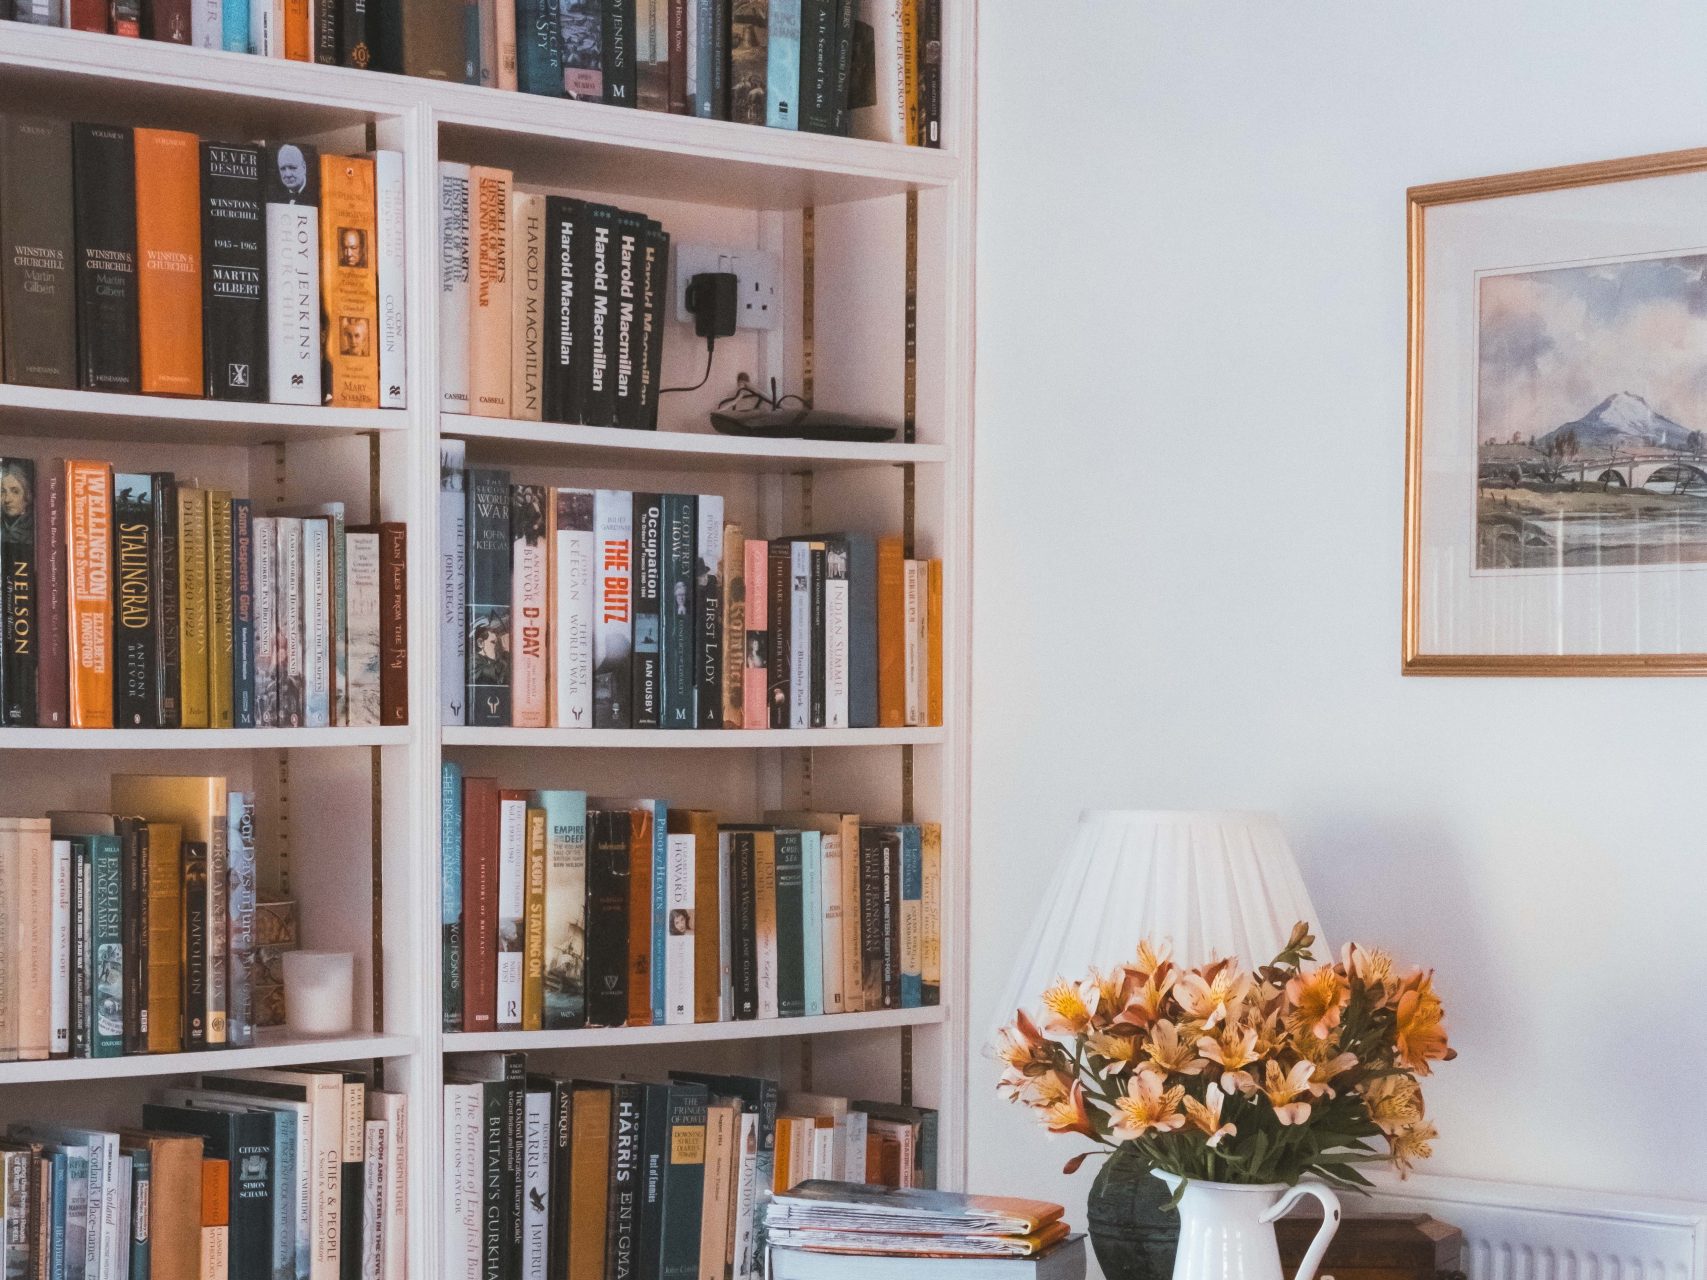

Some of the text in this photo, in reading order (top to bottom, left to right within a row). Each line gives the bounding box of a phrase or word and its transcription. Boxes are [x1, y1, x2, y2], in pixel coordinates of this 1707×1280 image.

[536, 21, 548, 50] SPY
[613, 15, 623, 68] JENKINS
[210, 151, 258, 165] NEVER
[210, 163, 258, 177] DESPAIR
[210, 199, 259, 210] WINSTON S.
[211, 208, 258, 220] CHURCHILL
[488, 179, 498, 283] HISTORY OF THE
[497, 180, 506, 283] LIDDELL HART'S
[86, 249, 132, 263] WINSTON S.
[87, 260, 133, 272] CHURCHILL
[479, 177, 489, 307] SECOND WORLD WAR
[96, 285, 125, 297] Gilbert
[97, 274, 125, 286] Martin
[213, 270, 259, 282] MARTIN
[213, 281, 260, 295] GILBERT
[296, 215, 311, 361] ROY JENKINS
[560, 222, 573, 365] Harold Macmillan
[525, 216, 539, 410] HAROLD MACMILLAN
[592, 227, 609, 392] Harold Macmillan
[618, 235, 635, 397] Harold Macmillan
[75, 474, 87, 593] The Years of the Sword
[89, 477, 106, 594] WELLINGTON
[604, 539, 629, 571] THE
[641, 507, 660, 599] Occupation
[672, 520, 681, 562] HOWE
[681, 505, 691, 578] GEOFFREY
[120, 523, 149, 629] STALINGRAD
[235, 506, 250, 622] Some Desperate Glory
[445, 554, 455, 624] JOHN KEEGAN
[523, 549, 533, 602] BEEVOR
[14, 561, 29, 654] NELSON
[603, 577, 630, 624] BLITZ
[81, 612, 93, 668] LONGFORD
[93, 612, 105, 673] ELIZABETH
[522, 607, 540, 658] D-DAY
[705, 597, 718, 685] FIRST LADY
[128, 645, 136, 697] BEEVOR
[137, 643, 145, 699] ANTONY
[644, 660, 654, 714] IAN OUSBY
[656, 818, 665, 854] PROOF
[97, 857, 108, 938] PLACE-NAMES
[107, 857, 119, 938] ENGLISH
[237, 803, 255, 943] Four Days in June
[529, 816, 544, 978] PAUL SCOTT STAYING ON
[656, 865, 665, 910] HEAVEN
[673, 842, 683, 903] HOWARD
[467, 1093, 478, 1121] The
[559, 1091, 569, 1147] ANTIQUES
[467, 1125, 478, 1175] Pattern
[489, 1117, 500, 1200] BRITAIN'S
[527, 1112, 540, 1179] HARRIS
[649, 1154, 659, 1167] Best
[87, 1145, 101, 1262] Scotland's Place-names
[326, 1150, 338, 1262] CITIES & PEOPLE
[464, 1180, 478, 1194] of
[617, 1102, 632, 1280] HARRIS ENIGMA
[648, 1177, 658, 1203] Enemies
[463, 1200, 478, 1253] English
